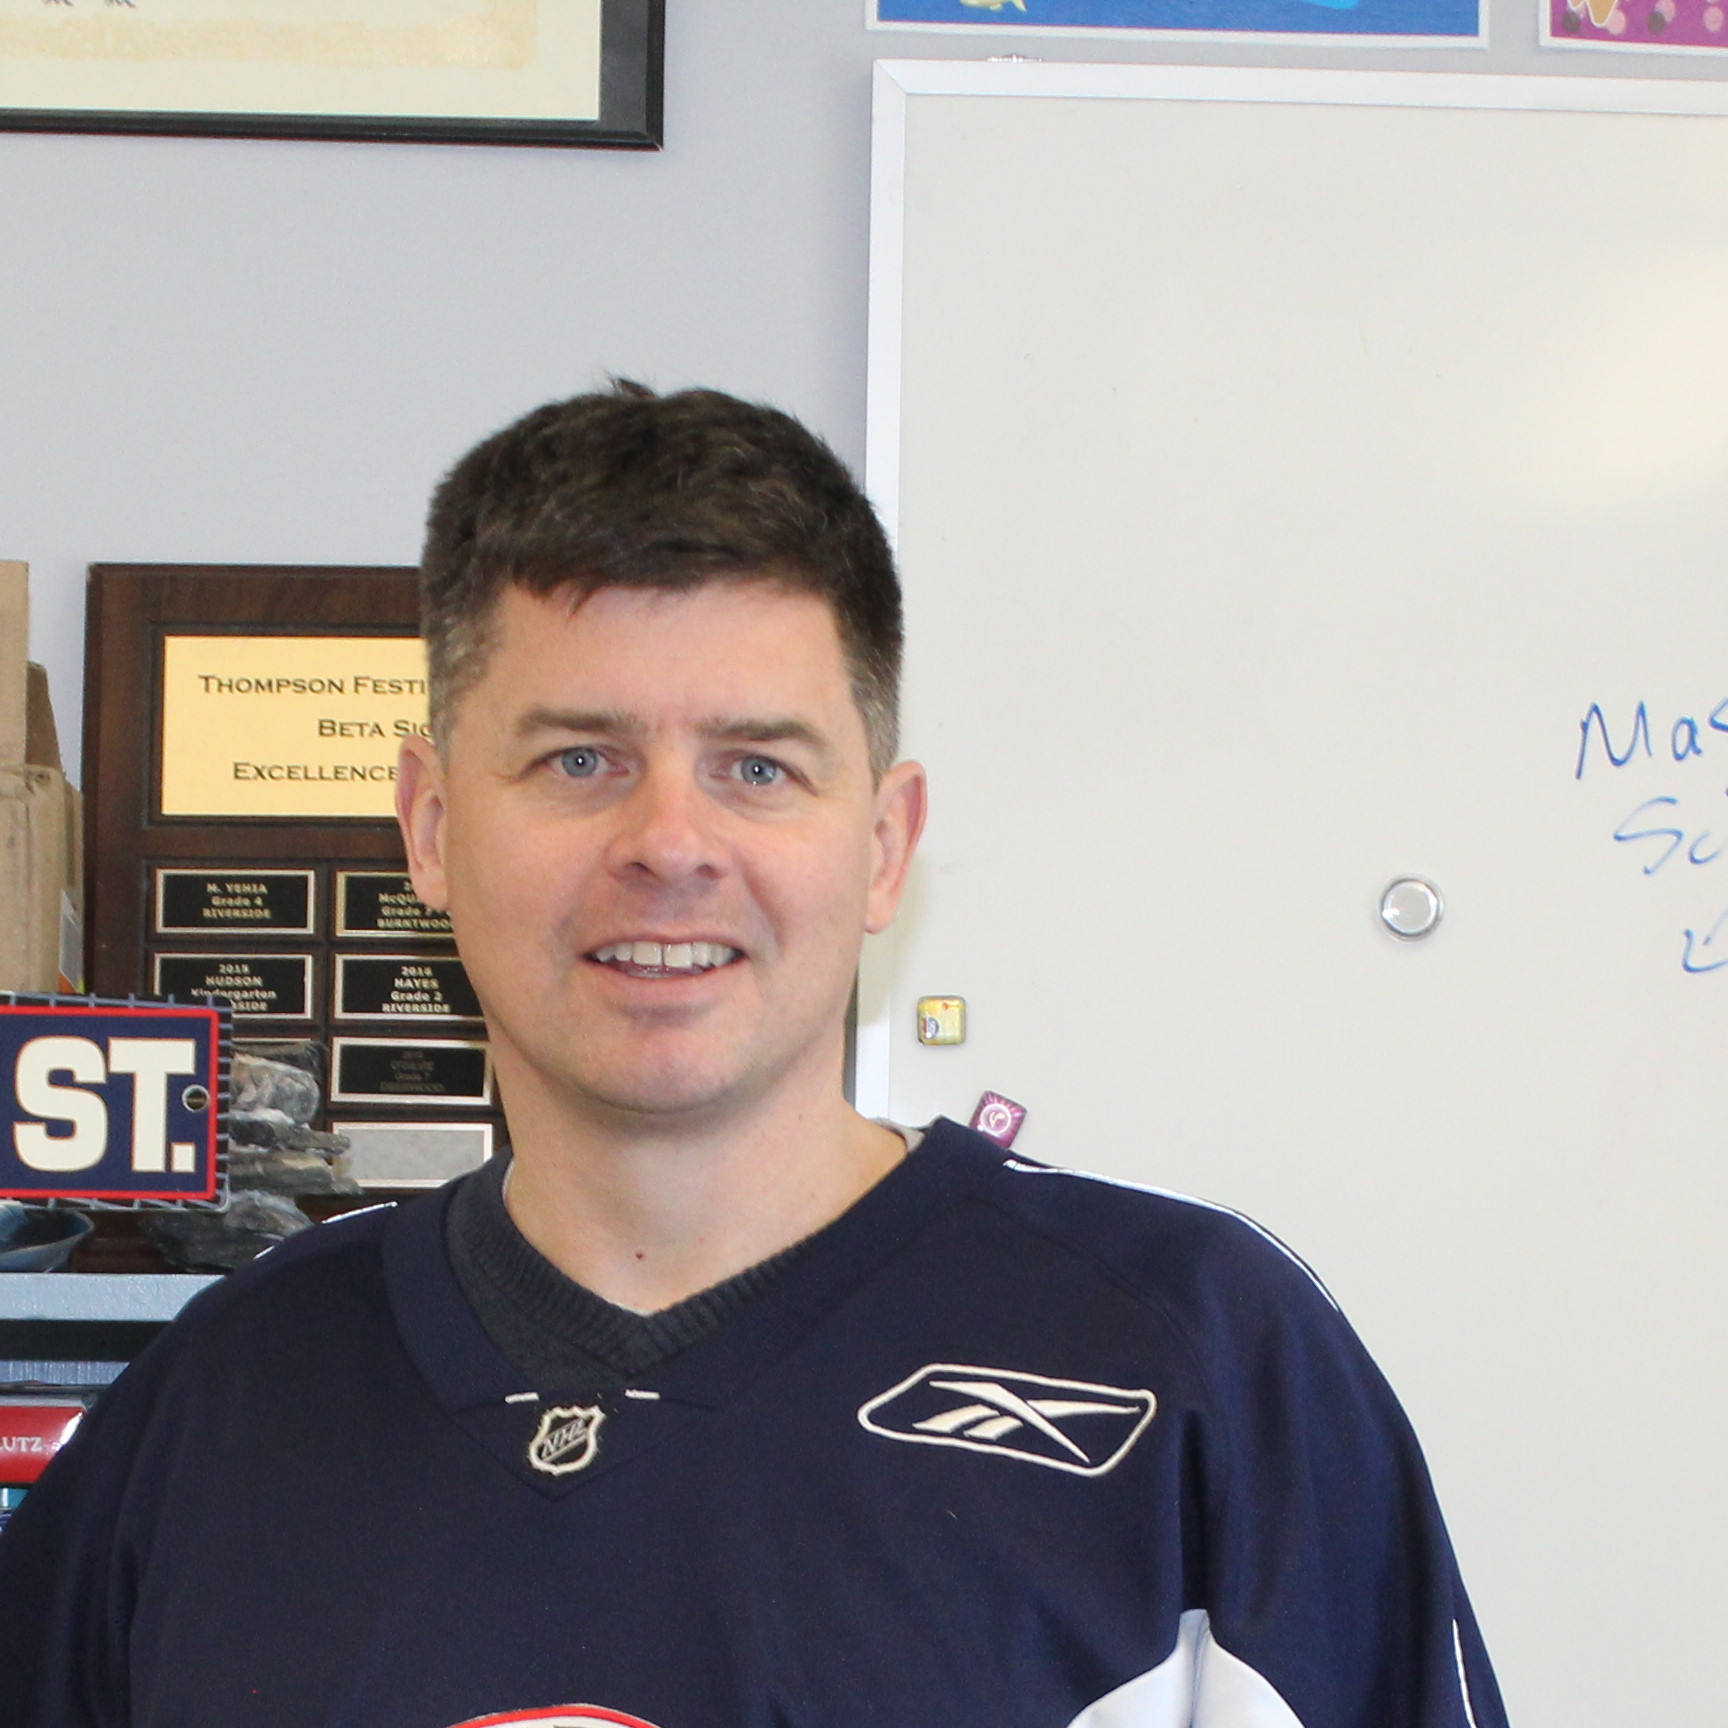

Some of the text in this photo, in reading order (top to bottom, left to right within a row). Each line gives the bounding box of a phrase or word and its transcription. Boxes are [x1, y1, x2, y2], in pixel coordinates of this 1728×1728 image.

[317, 719, 386, 738] BETA
[202, 907, 272, 920] RIVERSIDE
[381, 1002, 452, 1014] RIVERSIDE
[14, 1035, 196, 1172] ST.
